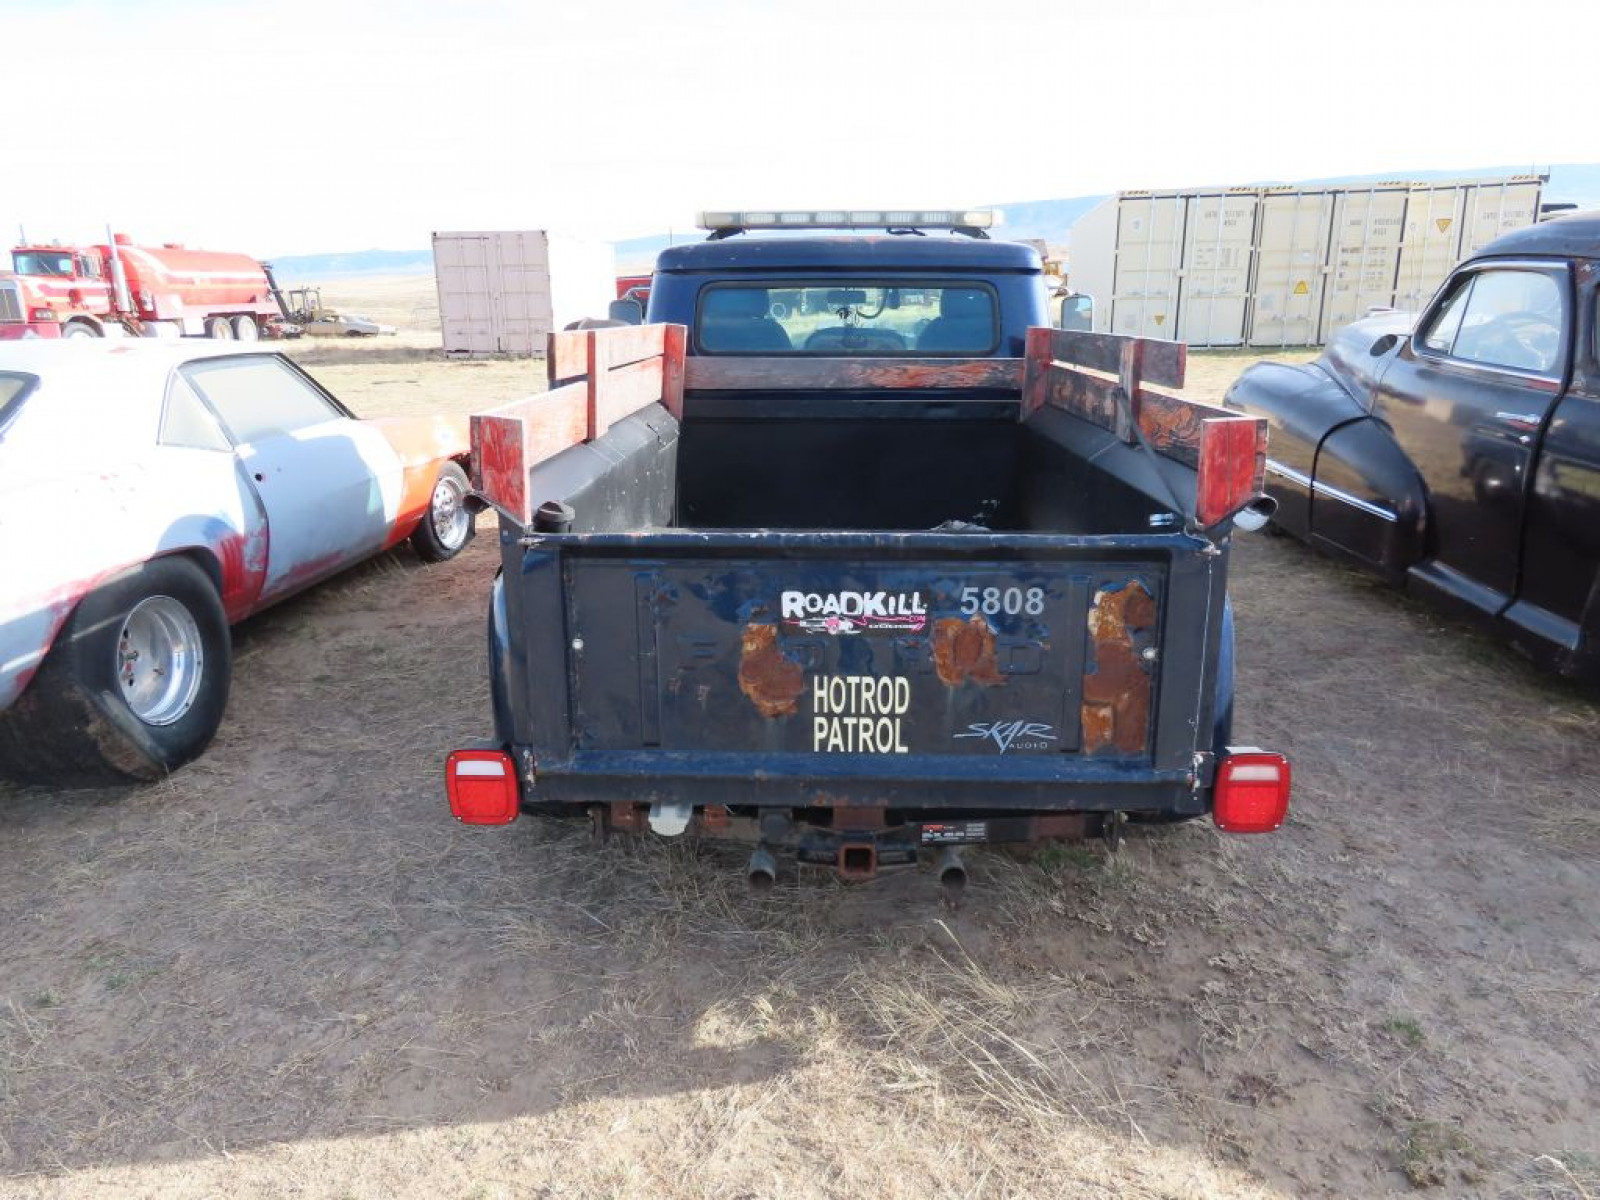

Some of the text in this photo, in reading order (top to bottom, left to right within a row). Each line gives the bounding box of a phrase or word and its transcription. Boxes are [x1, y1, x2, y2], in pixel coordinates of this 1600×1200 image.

[960, 586, 1045, 615] 5808
[813, 675, 910, 714] HOTROD
[813, 717, 909, 753] PATROL
[953, 720, 1058, 755] SKAR
